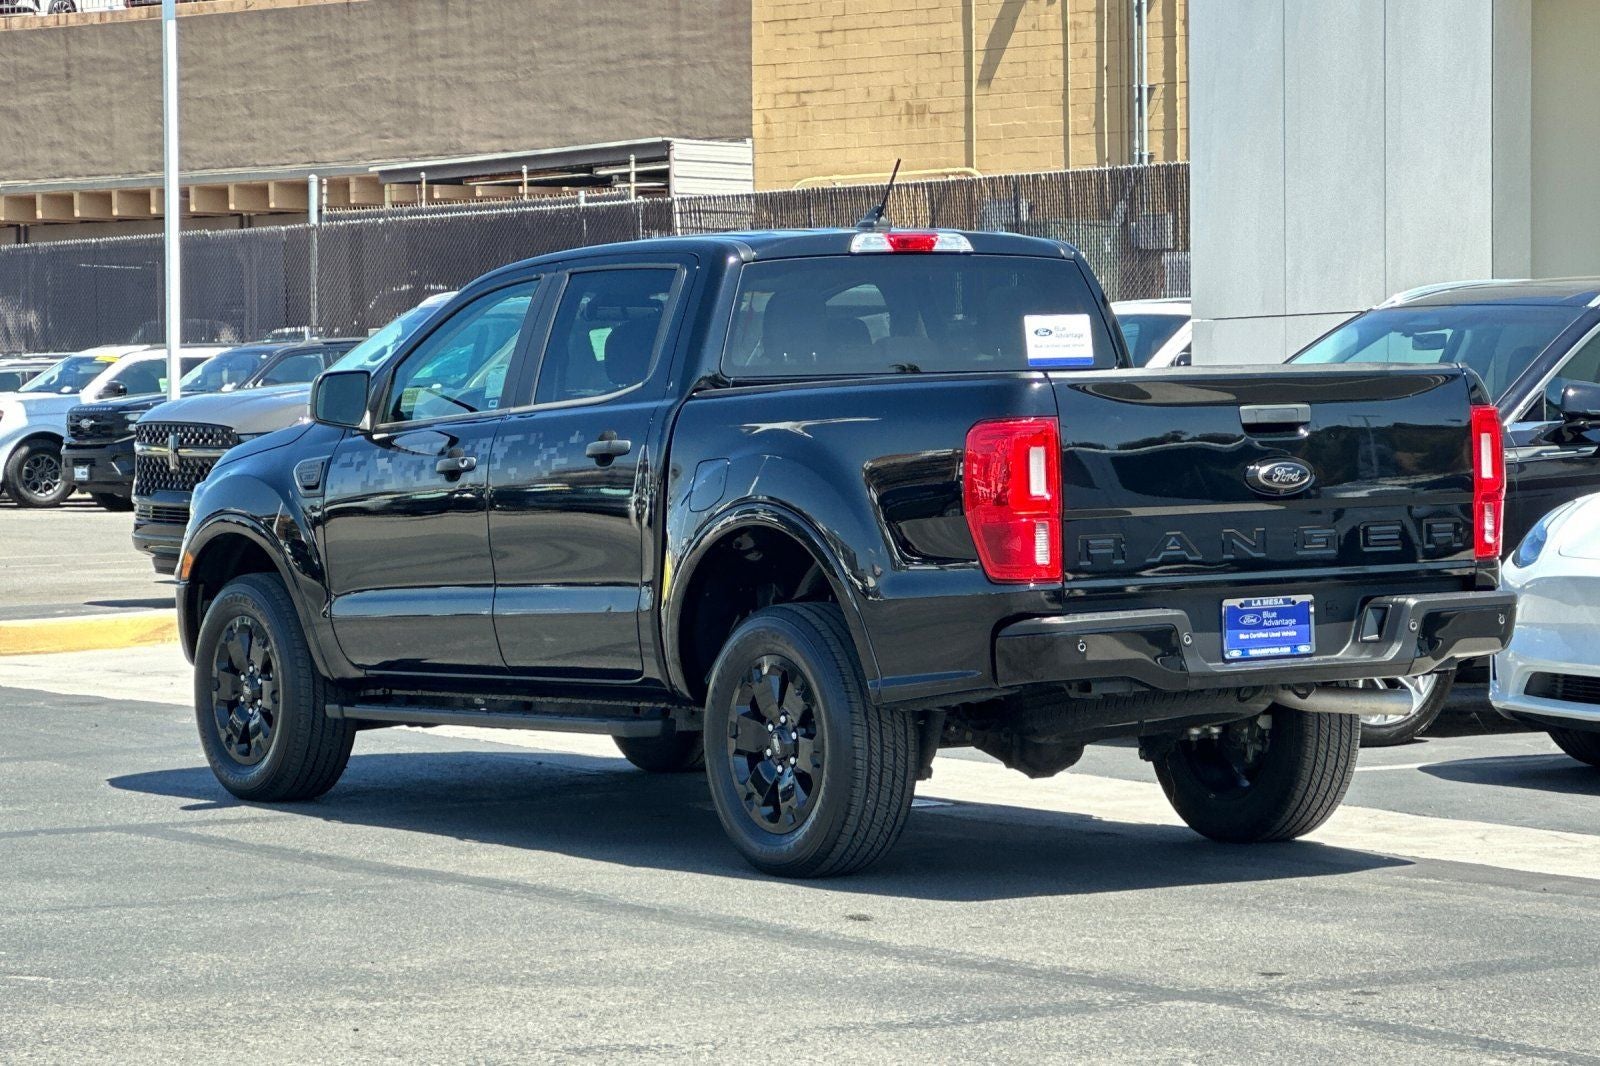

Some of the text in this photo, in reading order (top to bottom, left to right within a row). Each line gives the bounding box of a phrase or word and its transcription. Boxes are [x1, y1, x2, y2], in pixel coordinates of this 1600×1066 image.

[1272, 466, 1300, 482] Ford
[1078, 519, 1464, 566] RANGER
[1251, 598, 1284, 607] LA MESA
[1263, 618, 1297, 627] Advantage
